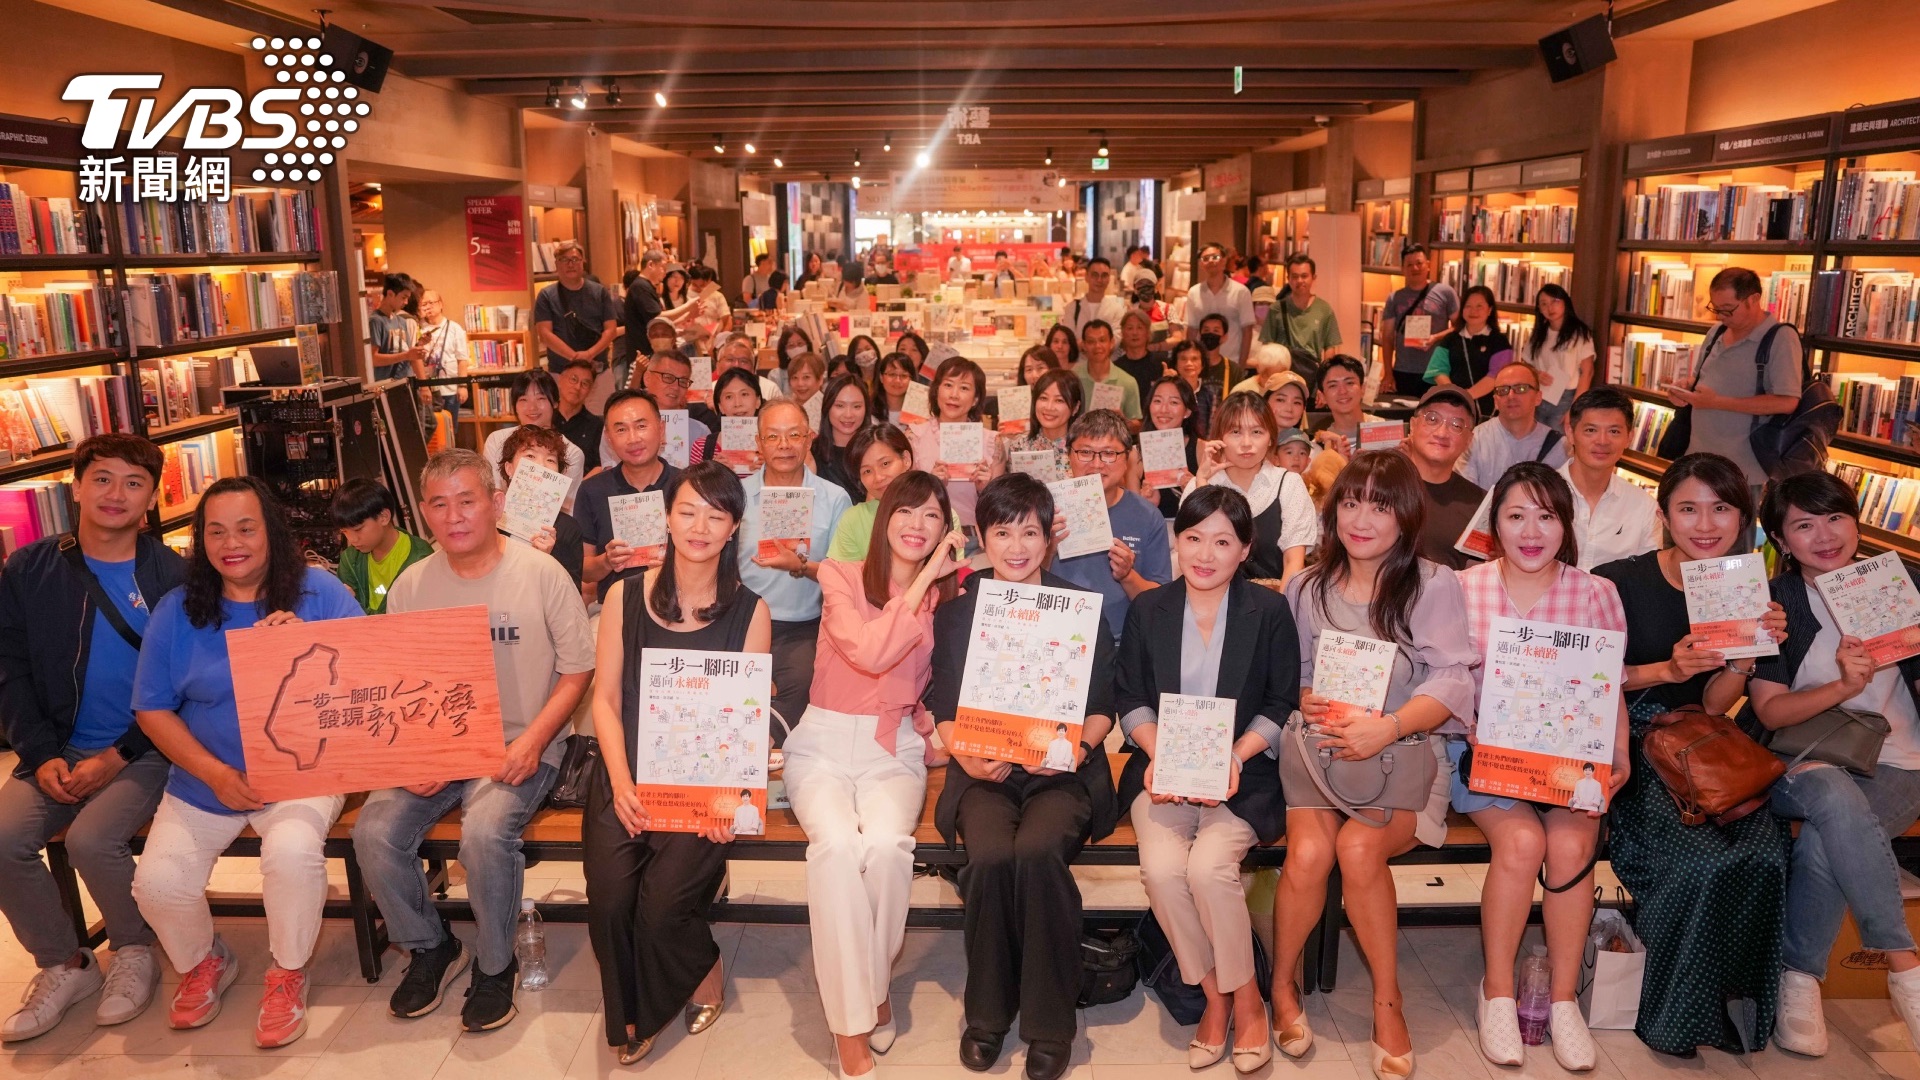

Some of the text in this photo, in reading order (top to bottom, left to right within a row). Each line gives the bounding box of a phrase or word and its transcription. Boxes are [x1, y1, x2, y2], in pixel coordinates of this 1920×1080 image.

[0, 131, 48, 144] RAPHIC DESIGN
[1753, 136, 1782, 146] ARCHITECTURE
[467, 207, 493, 215] OFFER
[470, 236, 481, 256] 5
[1845, 272, 1865, 338] ARCHITECT
[1824, 560, 1880, 585] 一步一腳印
[986, 588, 1071, 613] 一步一腳印
[983, 603, 1041, 622] 邁向永續路
[1498, 626, 1590, 651] 一步一腳印
[1496, 641, 1559, 661] 邁向永續路
[650, 656, 740, 678] 一步一腳印
[649, 674, 710, 690] 邁向永續路
[294, 685, 388, 709] 一步一腳印
